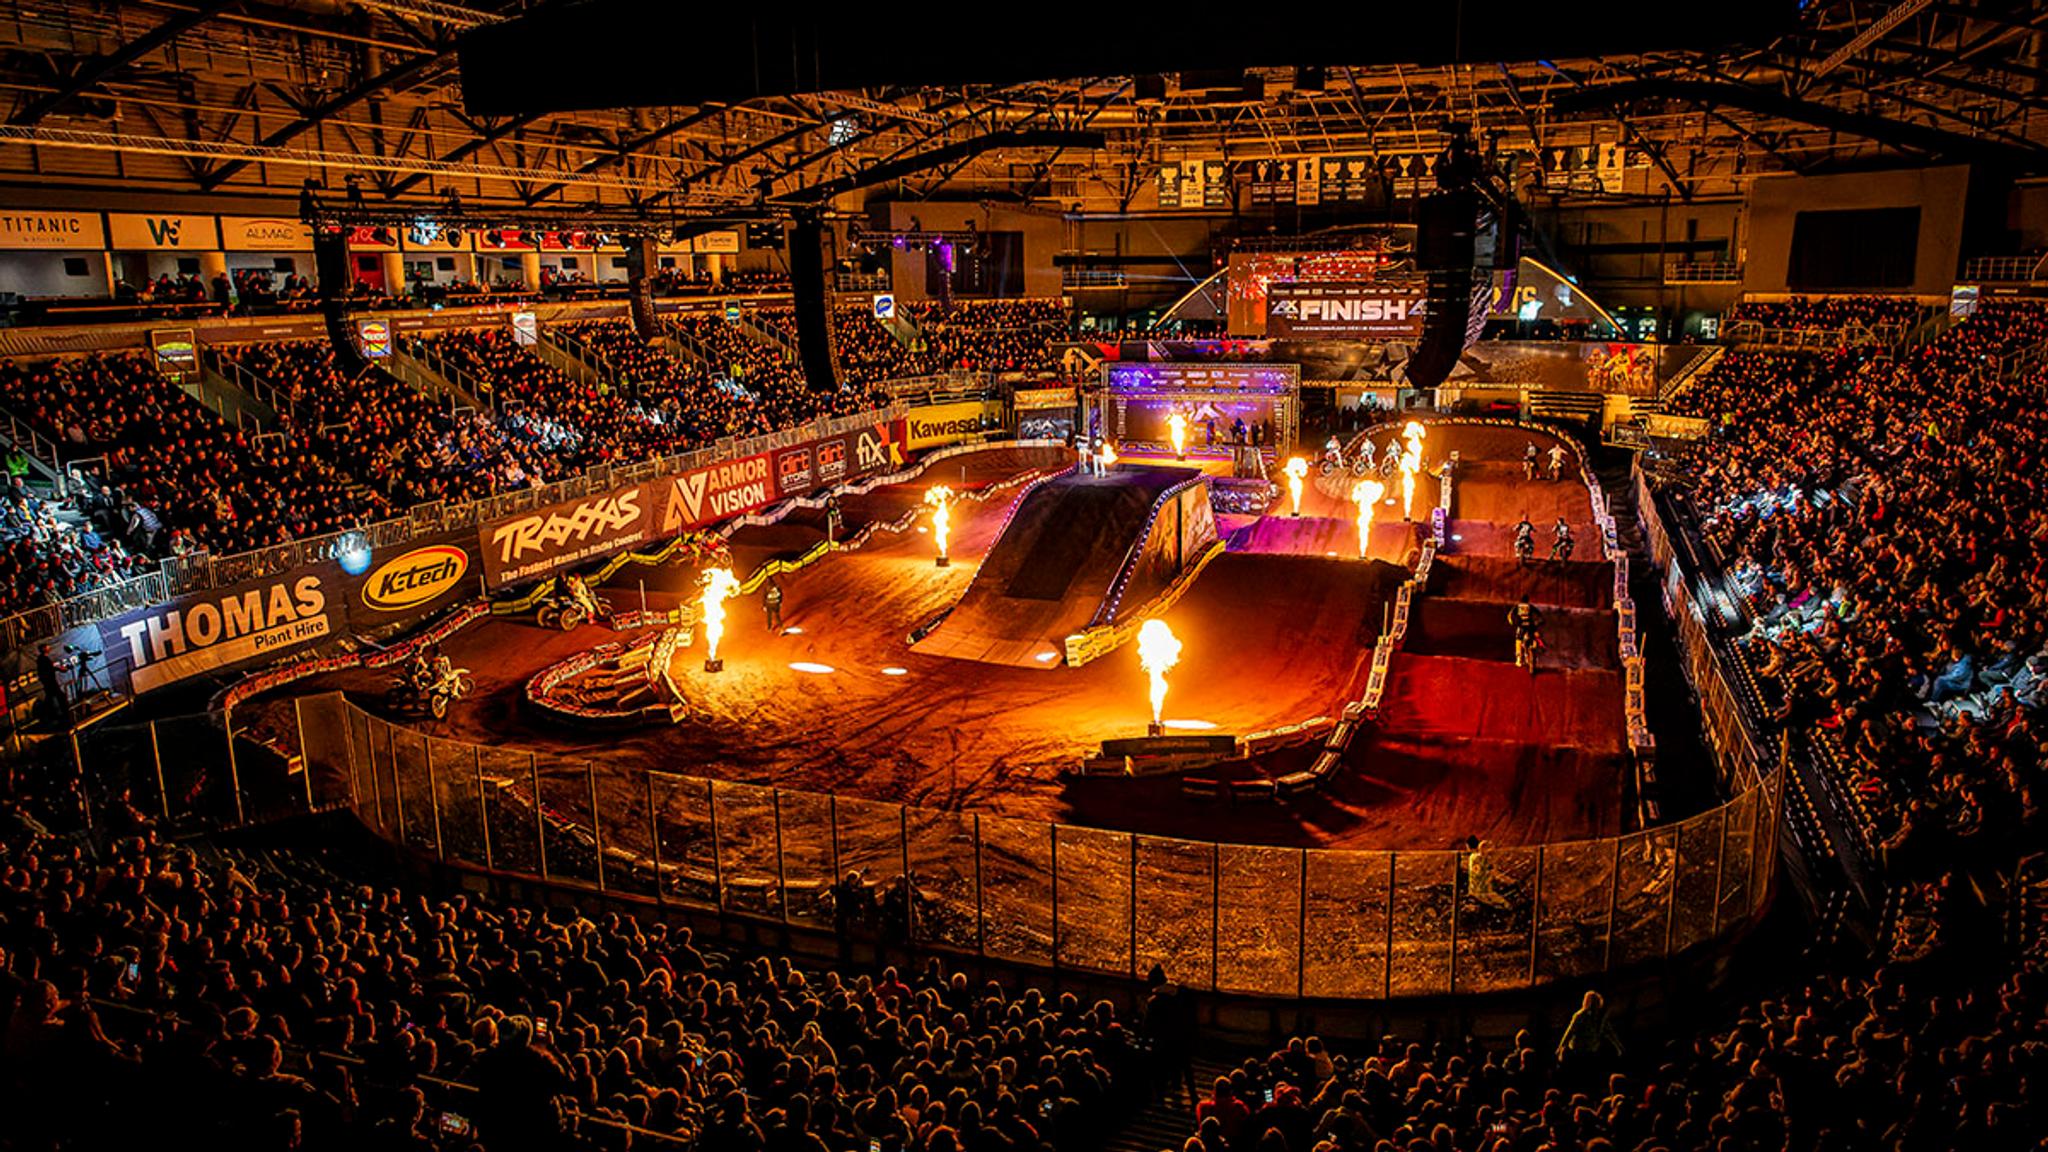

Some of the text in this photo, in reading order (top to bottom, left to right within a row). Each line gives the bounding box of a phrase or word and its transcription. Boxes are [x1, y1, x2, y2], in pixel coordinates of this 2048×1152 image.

[2, 217, 80, 233] TITANIC
[246, 228, 294, 240] ALMAC
[1300, 300, 1406, 320] FINISH
[708, 458, 767, 493] ARMOR
[709, 482, 766, 516] VISION
[492, 489, 641, 563] TRAXXAS
[121, 576, 325, 668] THOMAS
[254, 620, 324, 650] Plant Hire
